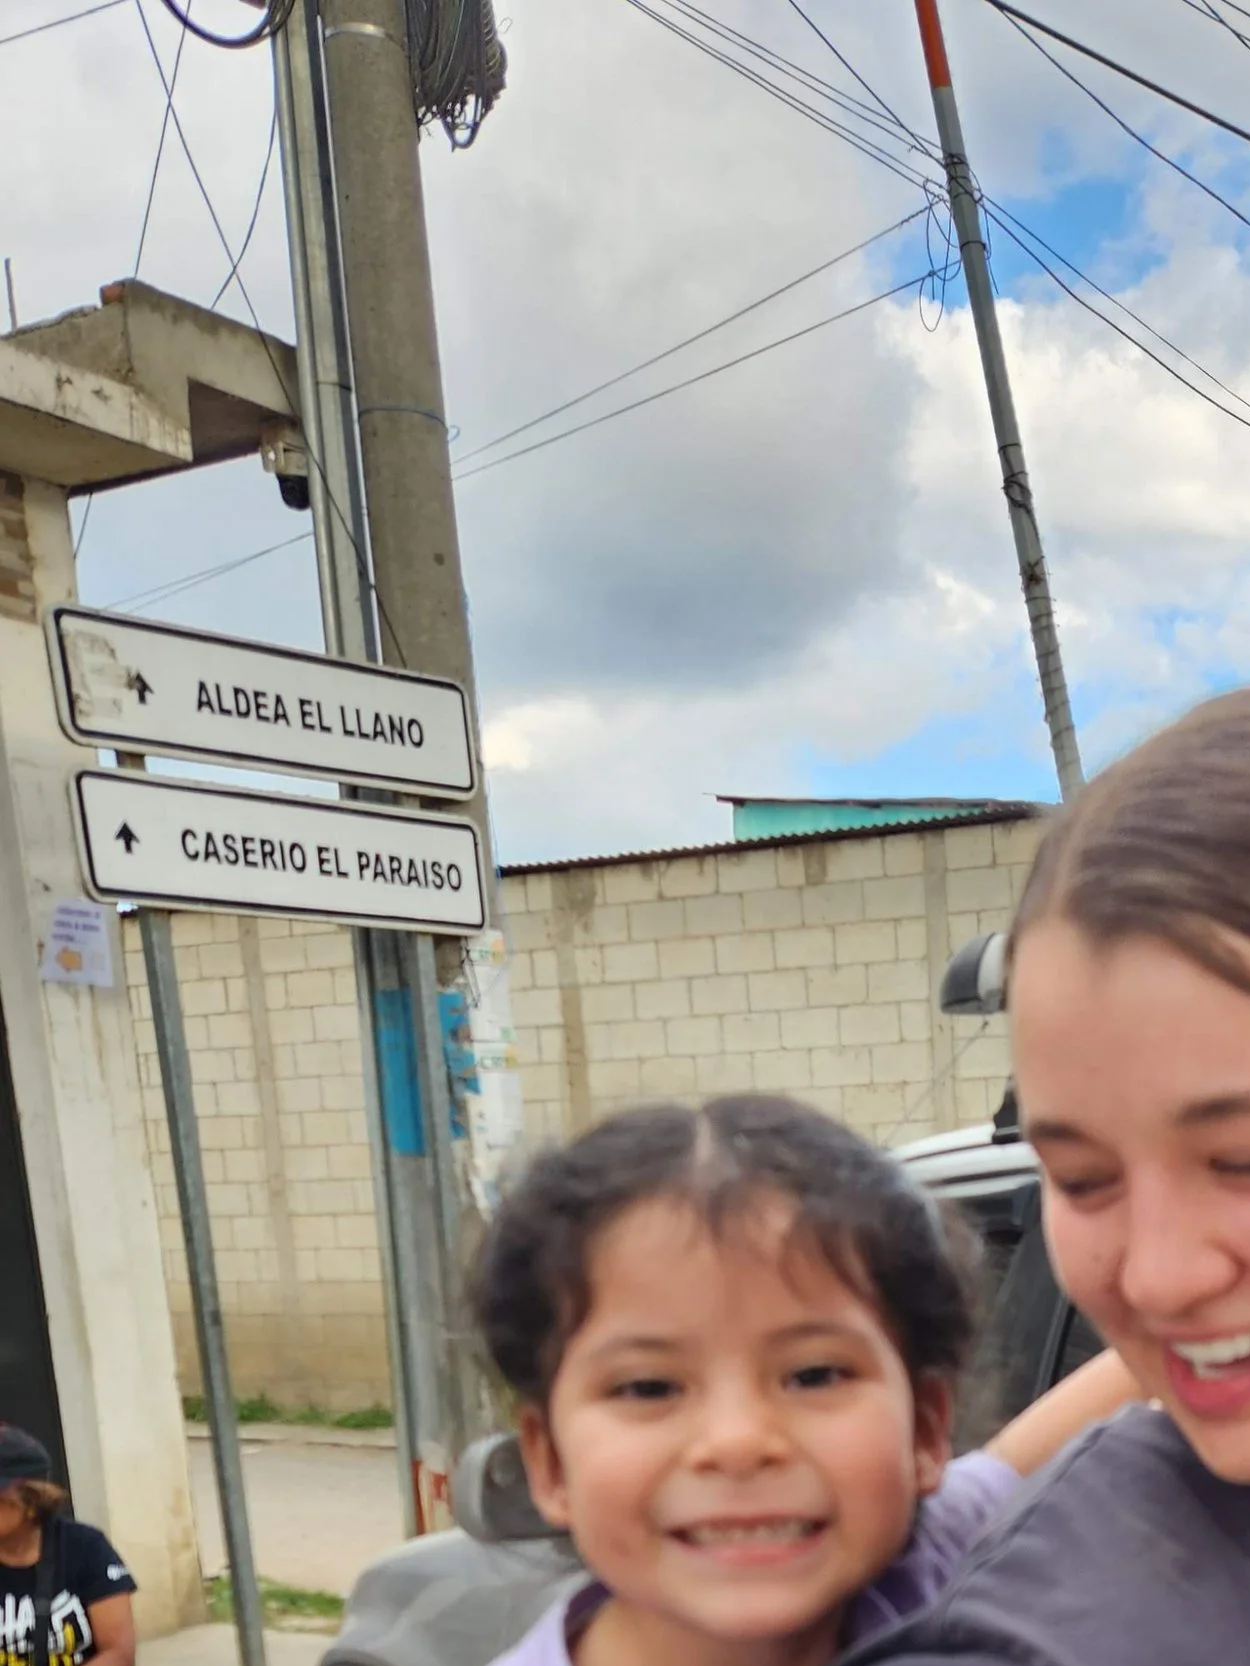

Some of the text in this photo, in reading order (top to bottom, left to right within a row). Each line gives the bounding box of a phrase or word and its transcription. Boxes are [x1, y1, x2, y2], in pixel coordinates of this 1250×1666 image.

[196, 680, 425, 749] ALDEA EL LLANO
[180, 828, 464, 893] CASERIO EL PARAISO
